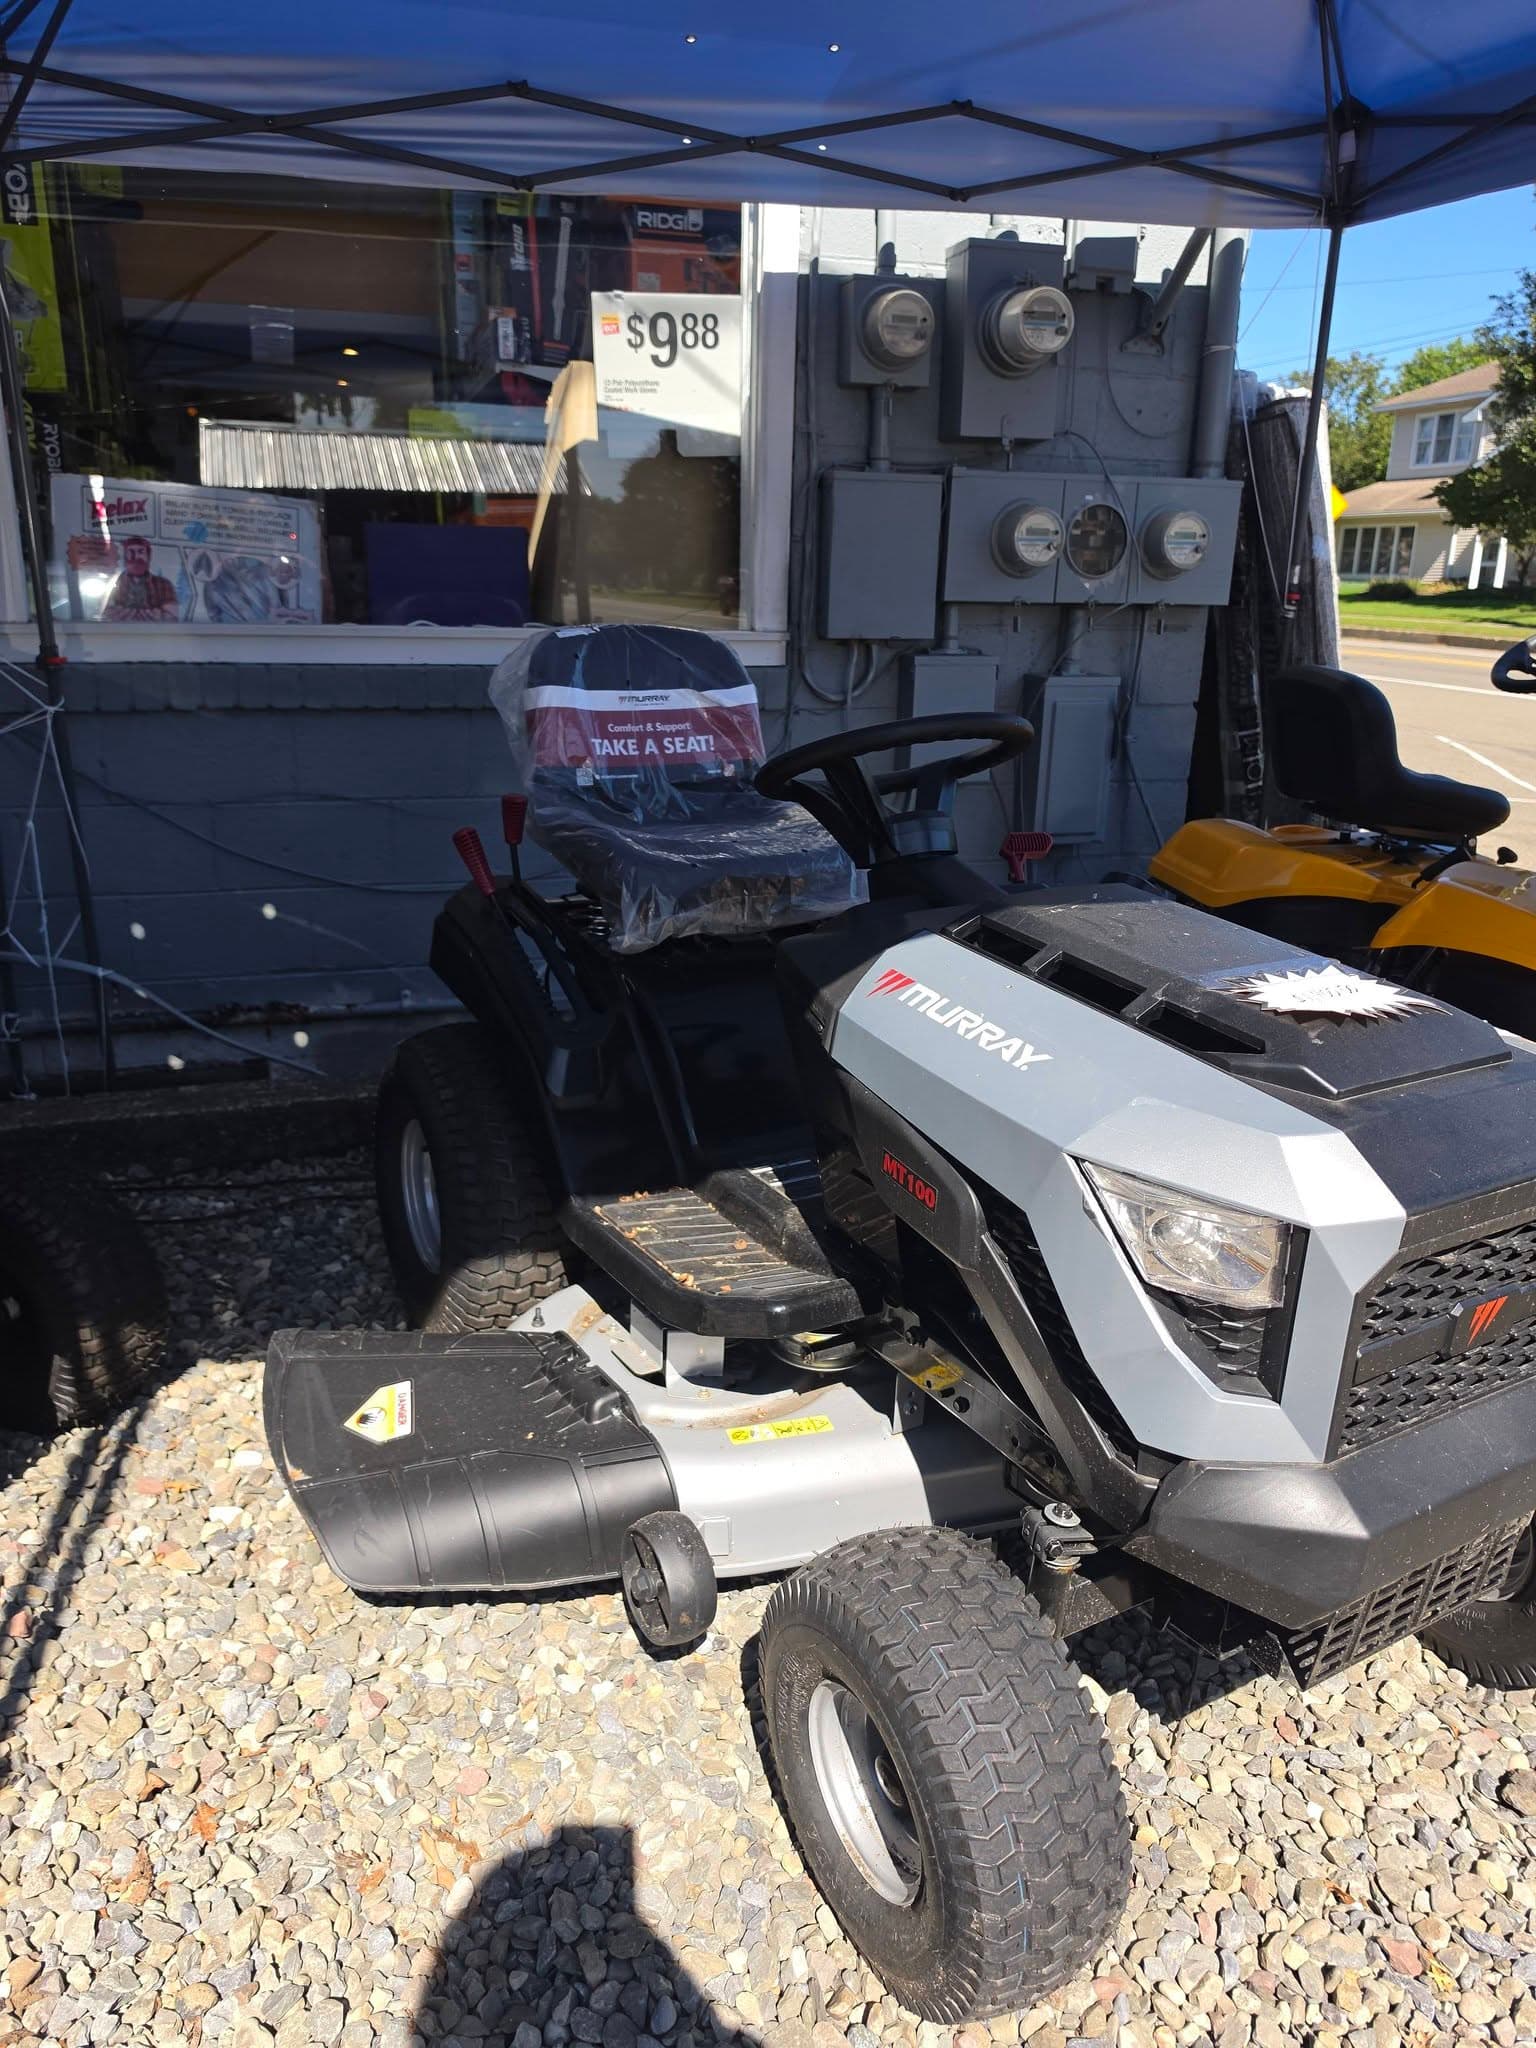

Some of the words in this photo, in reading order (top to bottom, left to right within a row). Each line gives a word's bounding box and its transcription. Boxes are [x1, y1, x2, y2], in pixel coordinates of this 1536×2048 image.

[636, 210, 704, 232] RIDGID
[43, 423, 63, 473] RYOBI
[626, 694, 671, 703] MURRAY
[607, 723, 644, 733] Comfort
[646, 722, 655, 732] &
[656, 721, 691, 734] Support
[591, 738, 640, 756] TAKE
[644, 738, 660, 755] A
[663, 734, 715, 754] SEAT!
[898, 983, 1054, 1071] MURRAY
[882, 1153, 937, 1210] MT100
